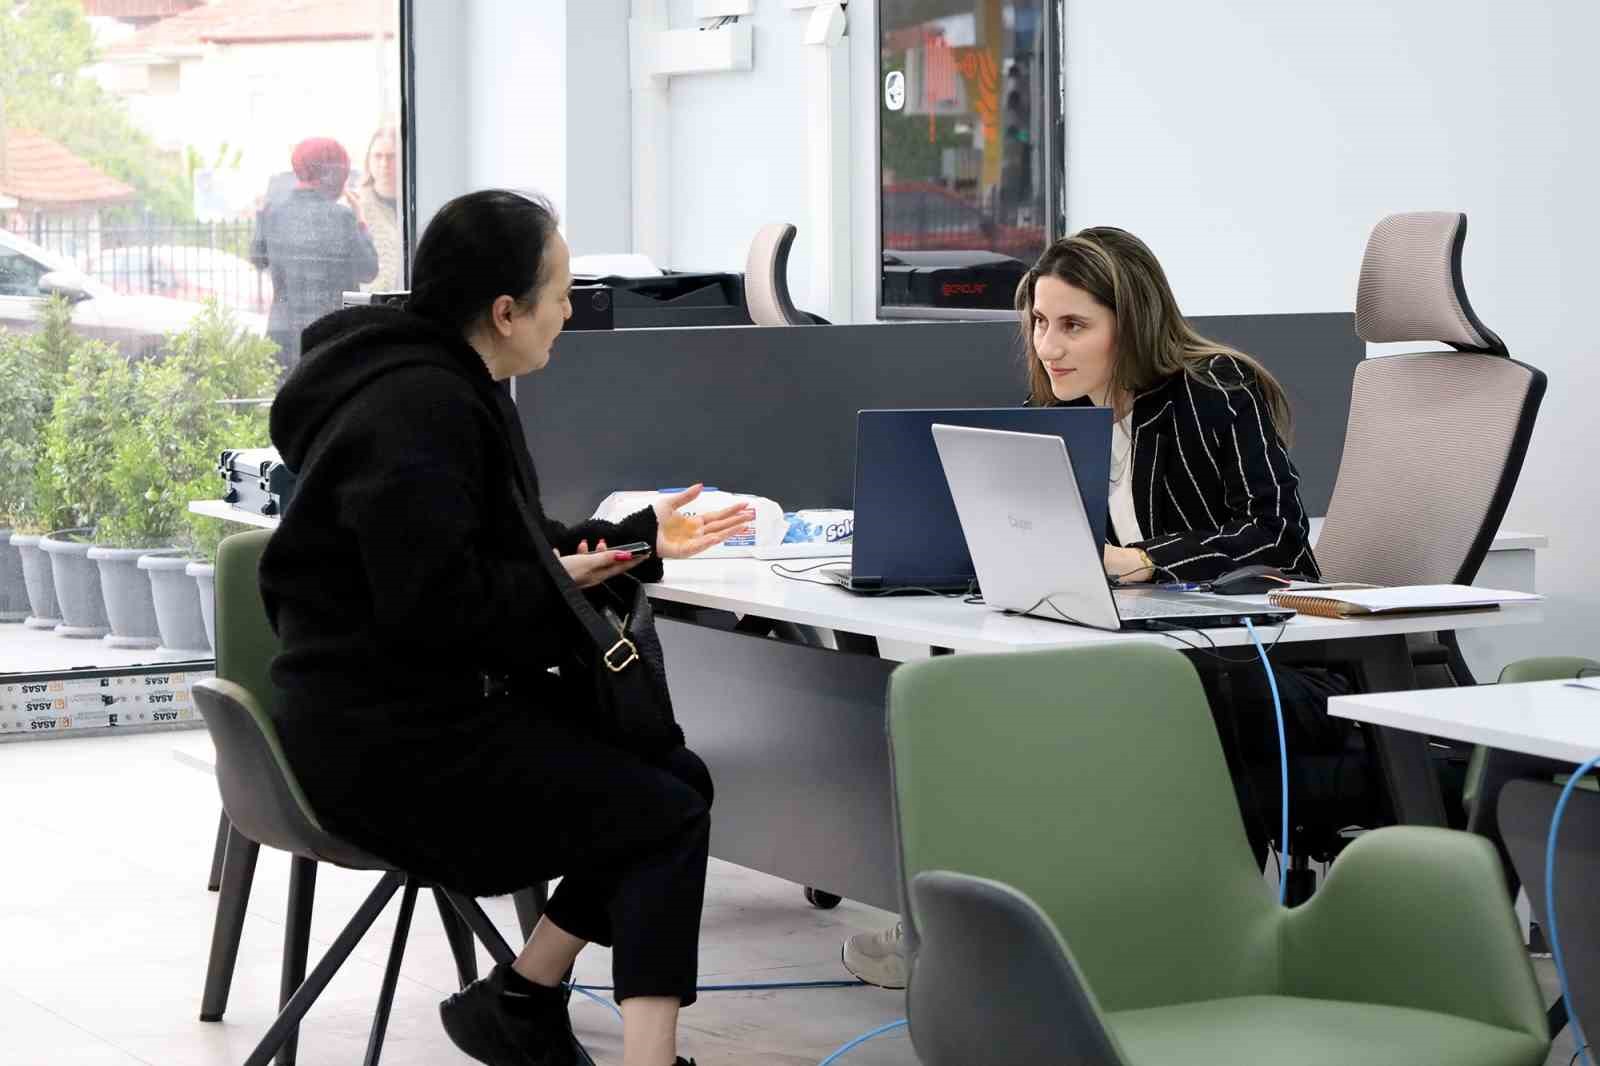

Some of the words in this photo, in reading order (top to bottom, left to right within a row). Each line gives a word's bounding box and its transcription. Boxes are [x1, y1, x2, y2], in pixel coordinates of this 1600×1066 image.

[145, 677, 169, 685] ASAS
[21, 684, 47, 693] ASAS
[149, 694, 173, 703] ASAS
[25, 702, 52, 711] ASAS
[152, 712, 178, 720] ASAS
[30, 720, 56, 729] ASAS
